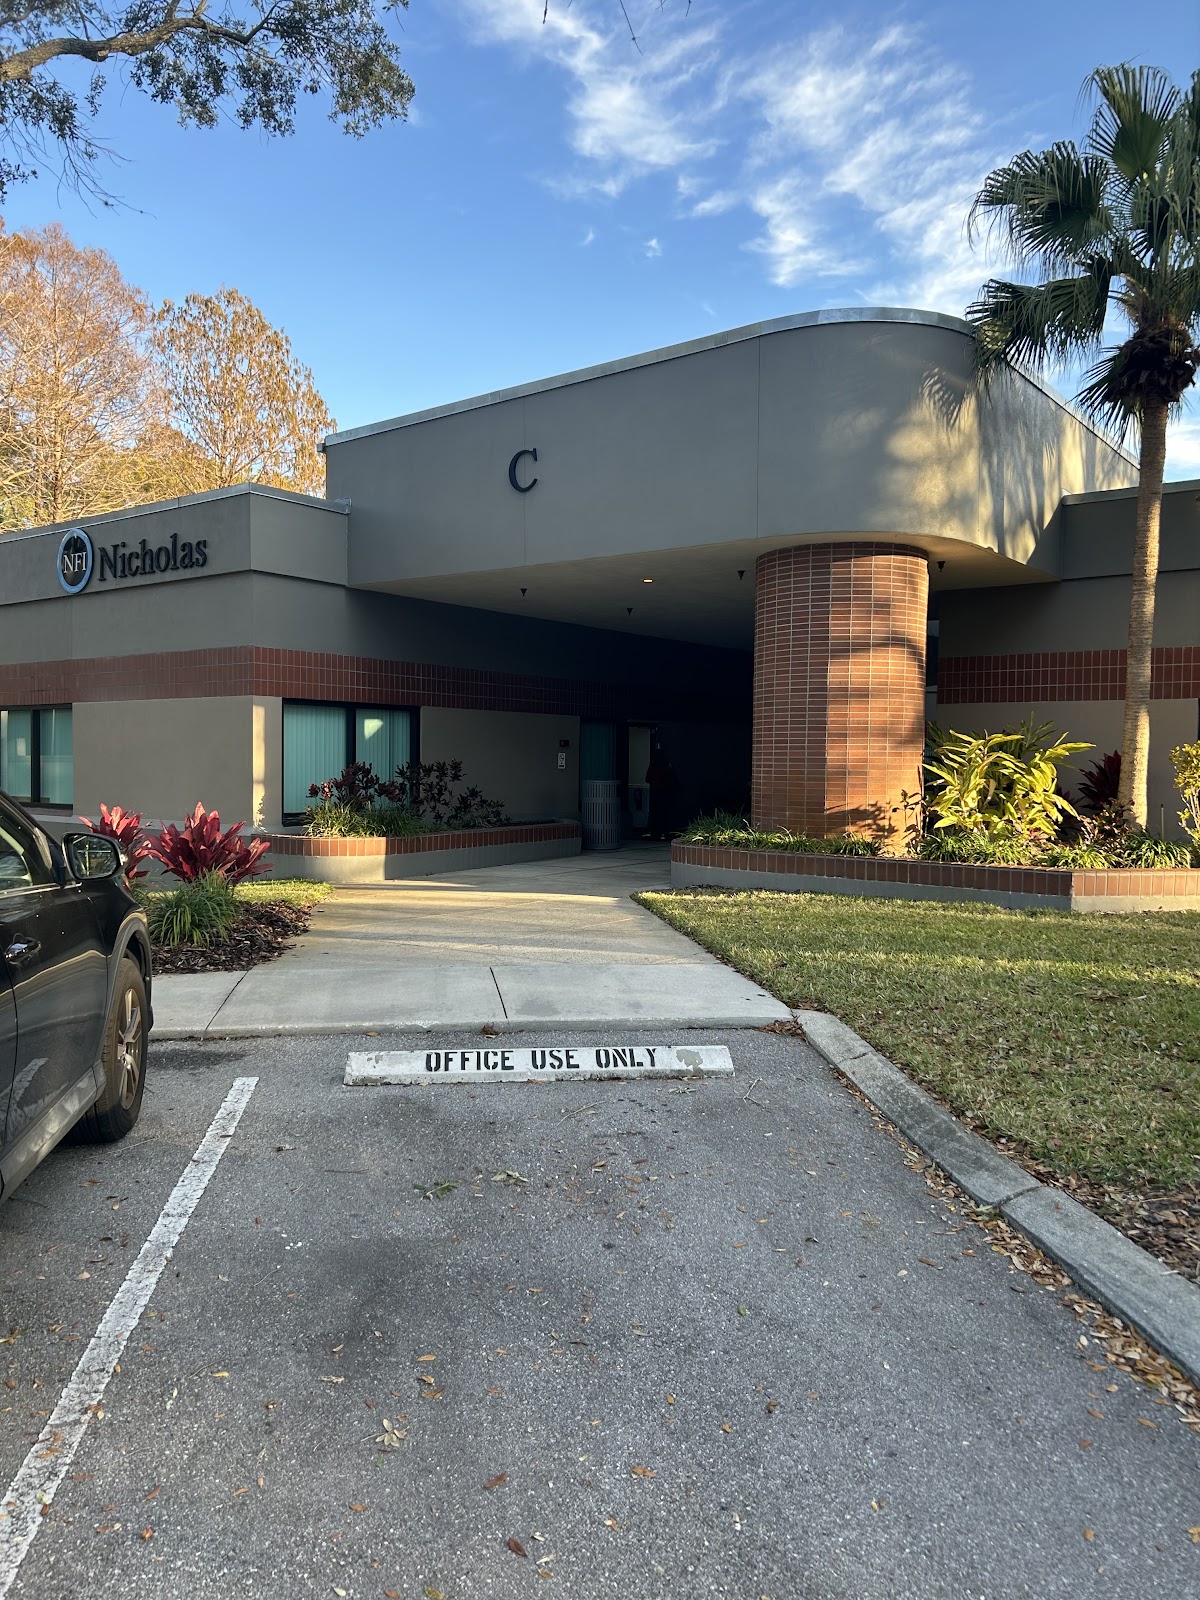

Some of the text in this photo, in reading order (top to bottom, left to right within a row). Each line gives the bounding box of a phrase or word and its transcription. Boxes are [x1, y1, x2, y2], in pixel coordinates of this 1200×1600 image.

[508, 447, 538, 493] C
[63, 532, 208, 582] NFI Nicholas
[425, 1048, 658, 1073] OFFICE USE ONLY
